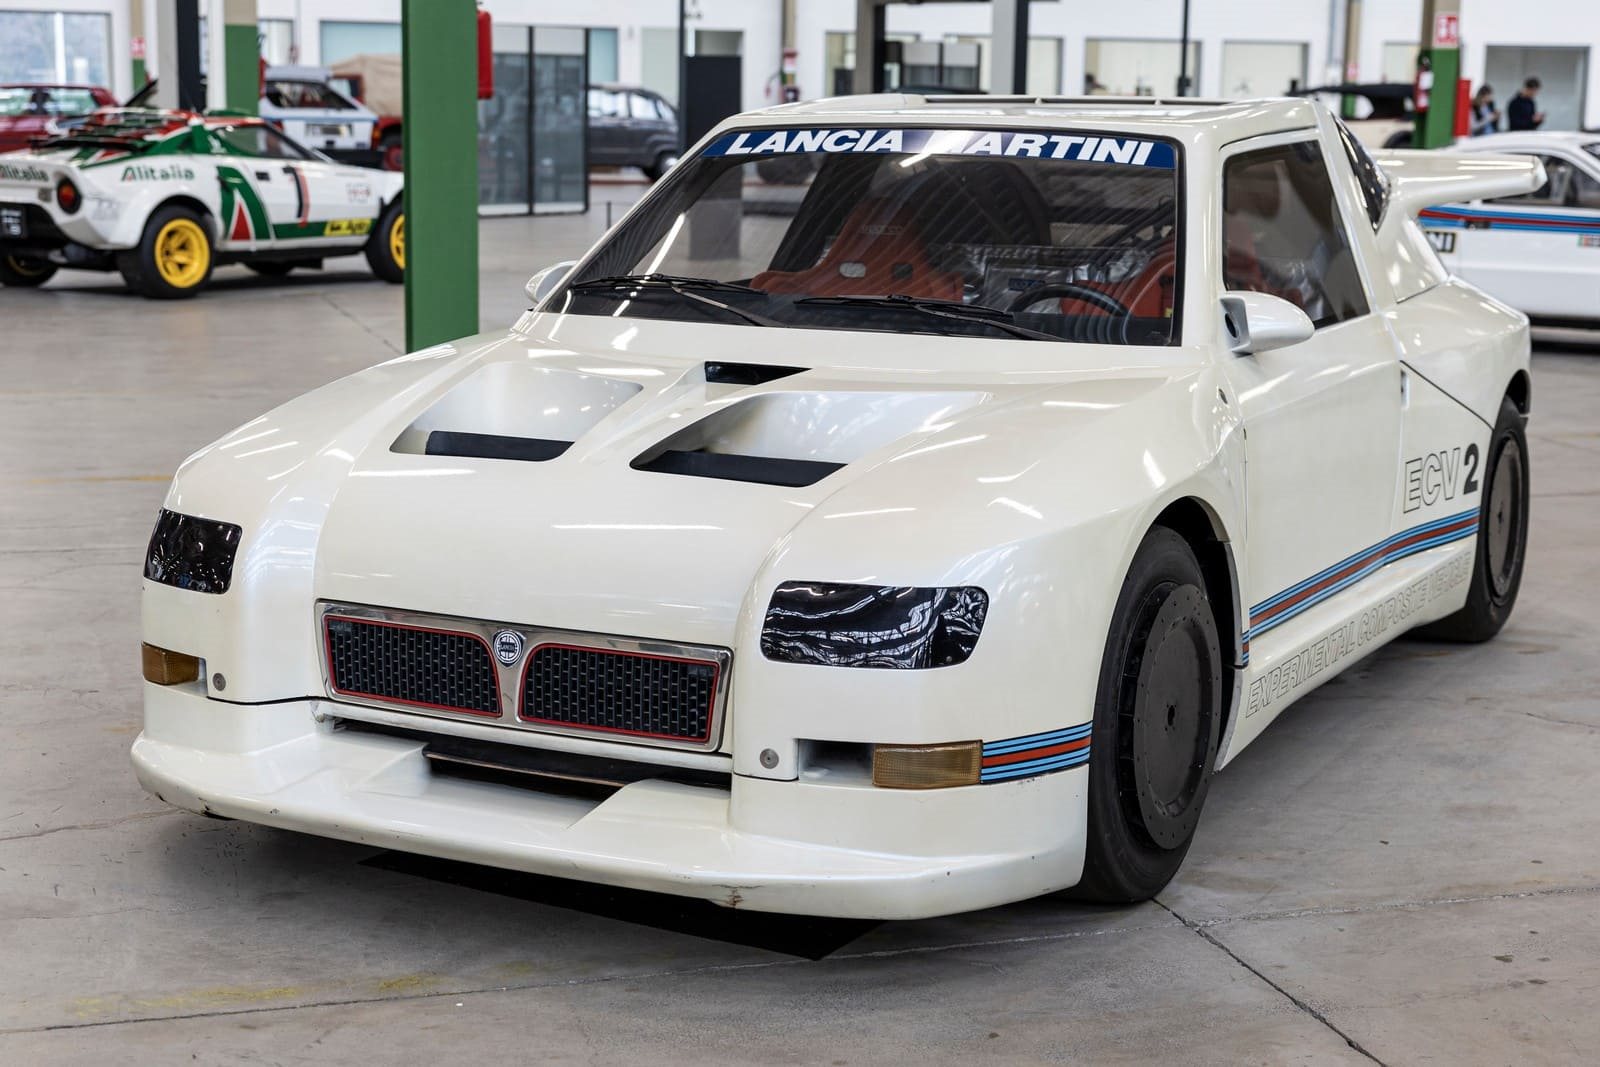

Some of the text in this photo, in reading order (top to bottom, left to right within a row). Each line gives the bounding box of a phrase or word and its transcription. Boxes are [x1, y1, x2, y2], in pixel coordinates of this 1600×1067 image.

[725, 129, 903, 154] LANCIA
[122, 165, 196, 182] Alitalia
[1403, 443, 1479, 514] ECV 2
[1246, 620, 1356, 719] EXPERIMENTAL
[1357, 576, 1429, 647] COMPOSITE
